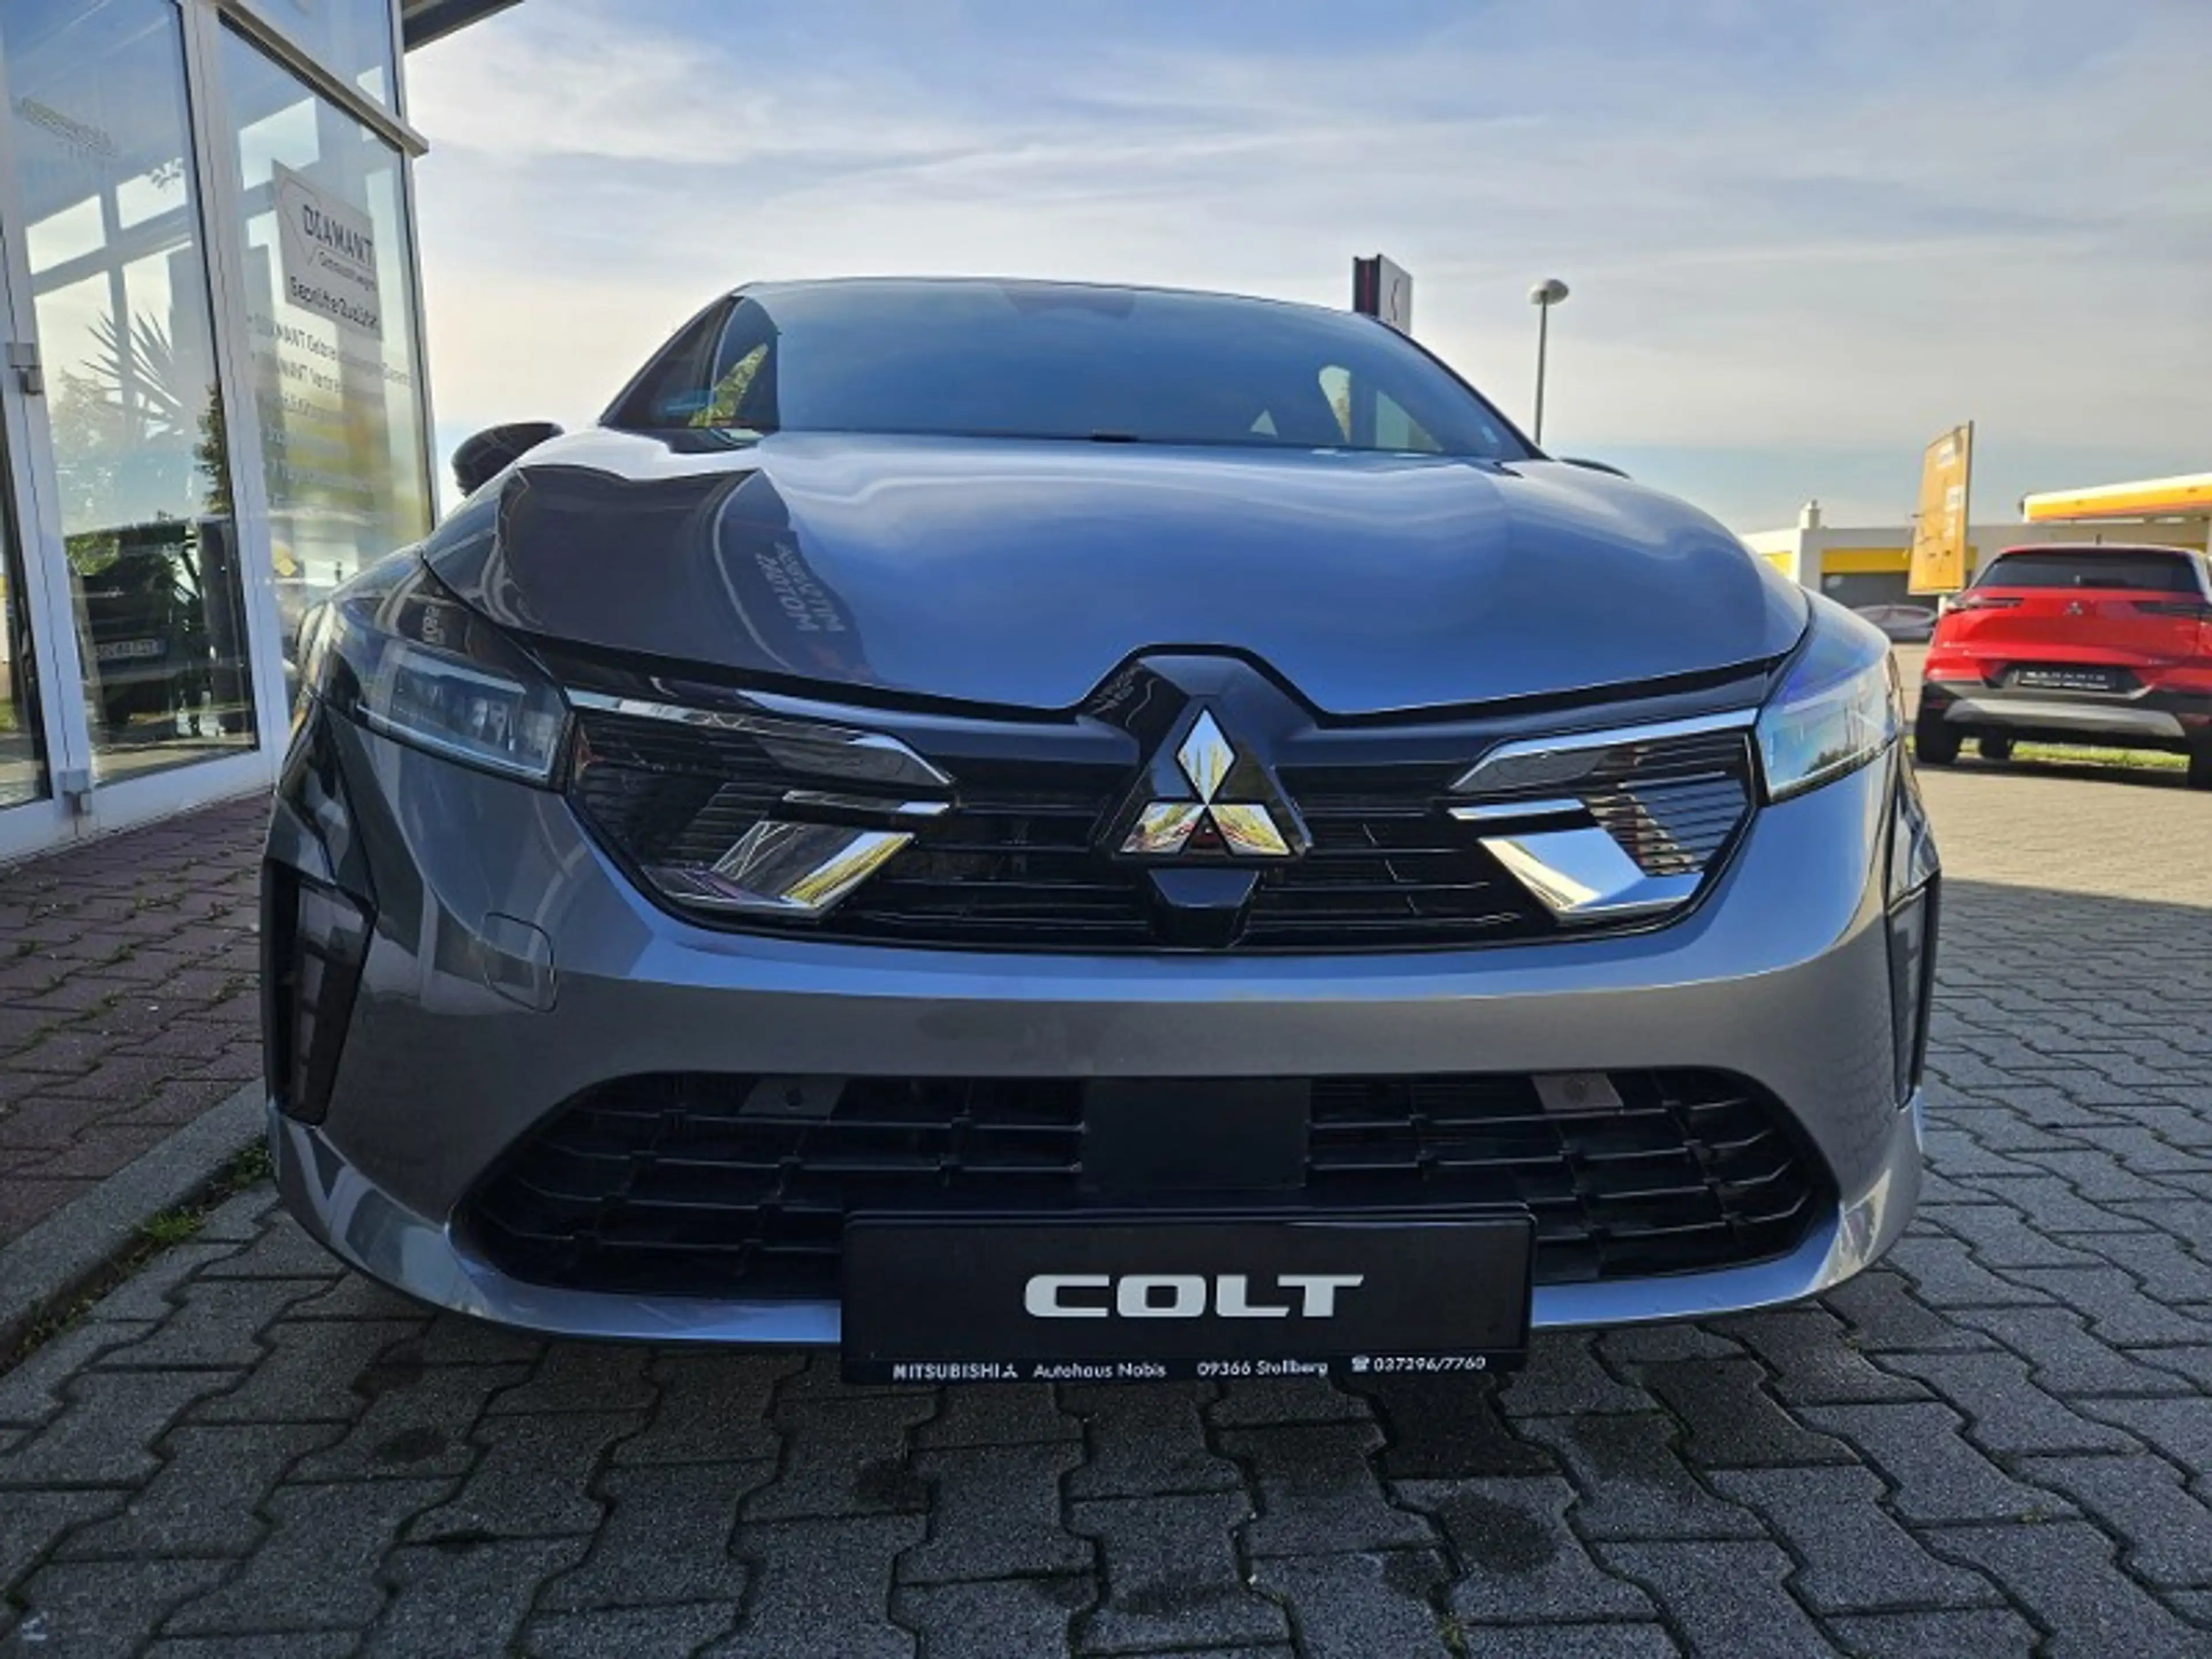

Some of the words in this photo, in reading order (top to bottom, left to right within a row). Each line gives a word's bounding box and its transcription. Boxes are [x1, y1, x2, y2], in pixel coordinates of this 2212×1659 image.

[1025, 1274, 1363, 1317] COLT
[892, 1363, 999, 1380] MITSUBISHI
[1033, 1363, 1113, 1378] Autohaus
[1116, 1362, 1166, 1377] Nobis
[1196, 1361, 1251, 1376] 09366
